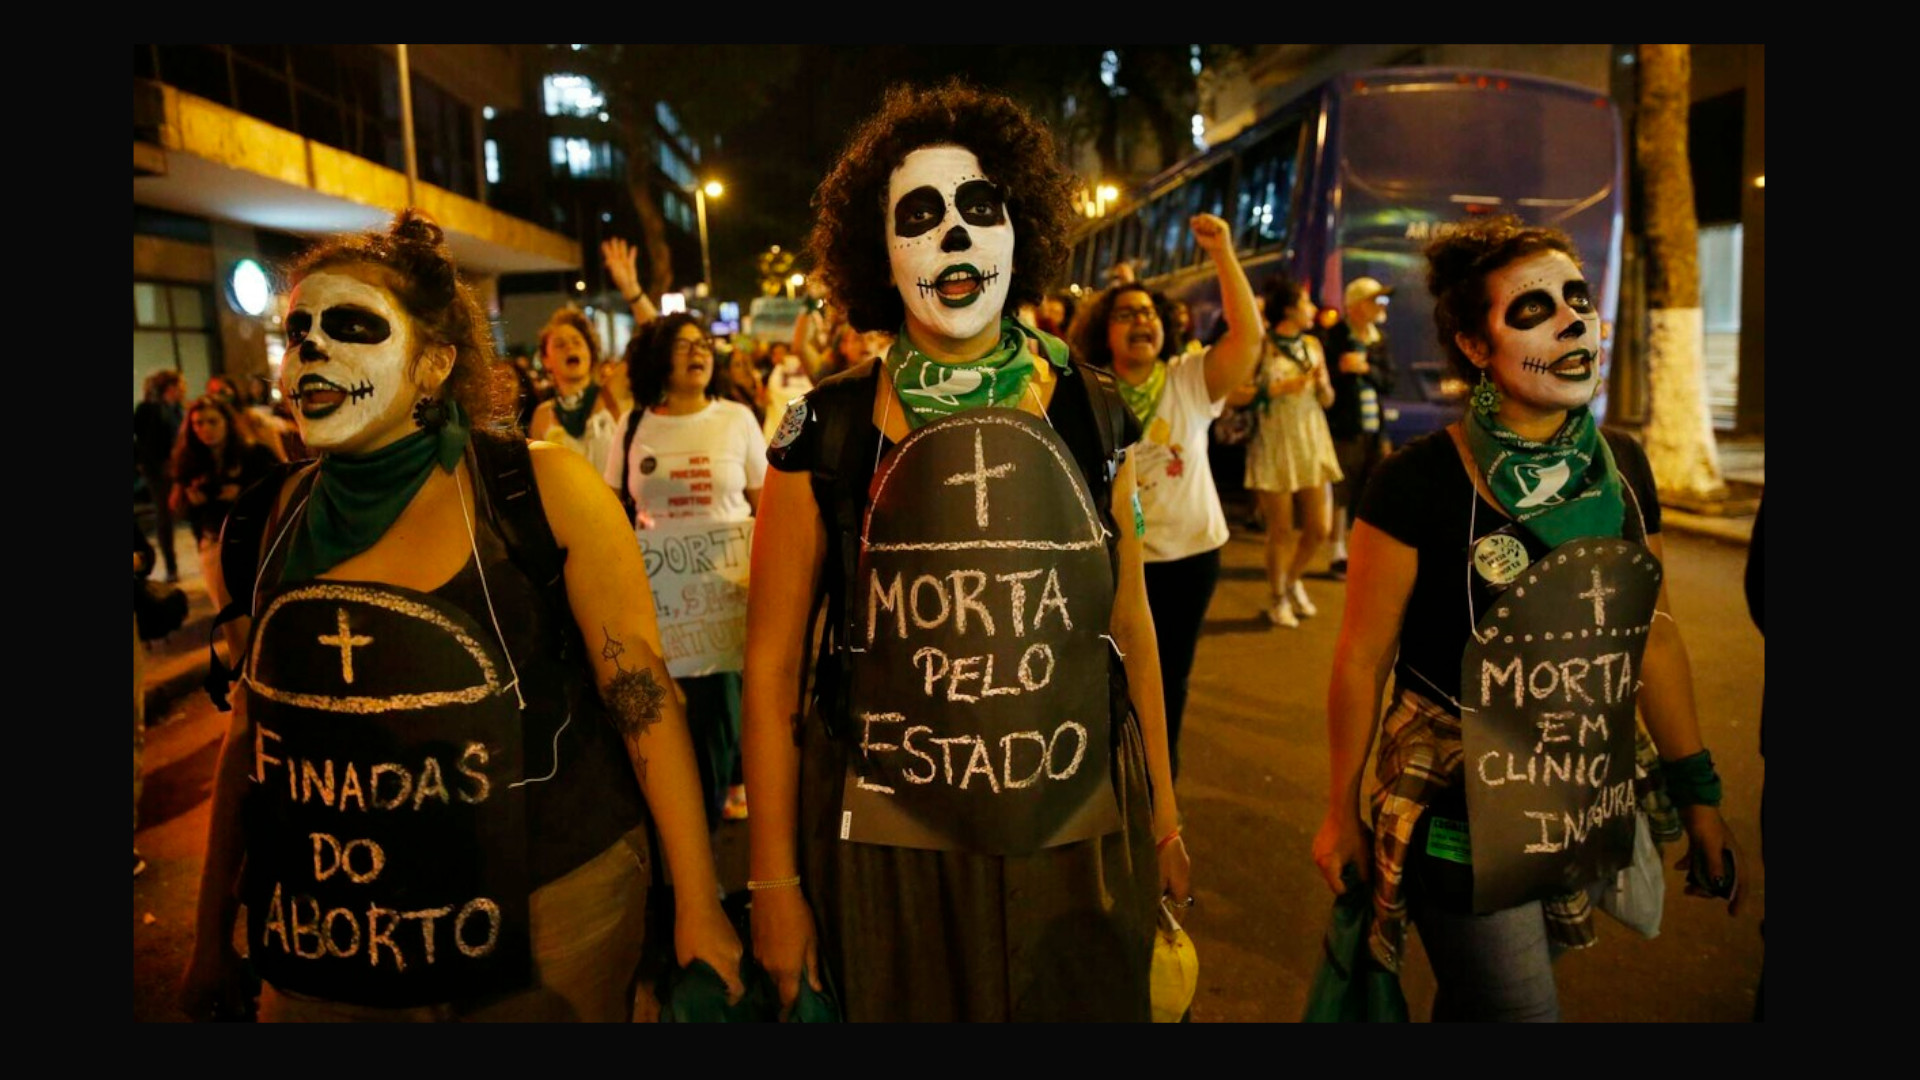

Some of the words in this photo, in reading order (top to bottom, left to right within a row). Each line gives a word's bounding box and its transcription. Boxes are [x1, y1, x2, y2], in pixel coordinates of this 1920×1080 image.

[643, 527, 751, 578] BORT
[865, 568, 1073, 646] MORTA
[912, 642, 1056, 703] PELO
[1481, 652, 1632, 708] MORTA
[857, 711, 1088, 794] ESTADO
[1536, 710, 1609, 747] EM
[249, 721, 490, 812] FINADAS
[308, 831, 386, 884] DO
[262, 881, 500, 970] ABORTO
